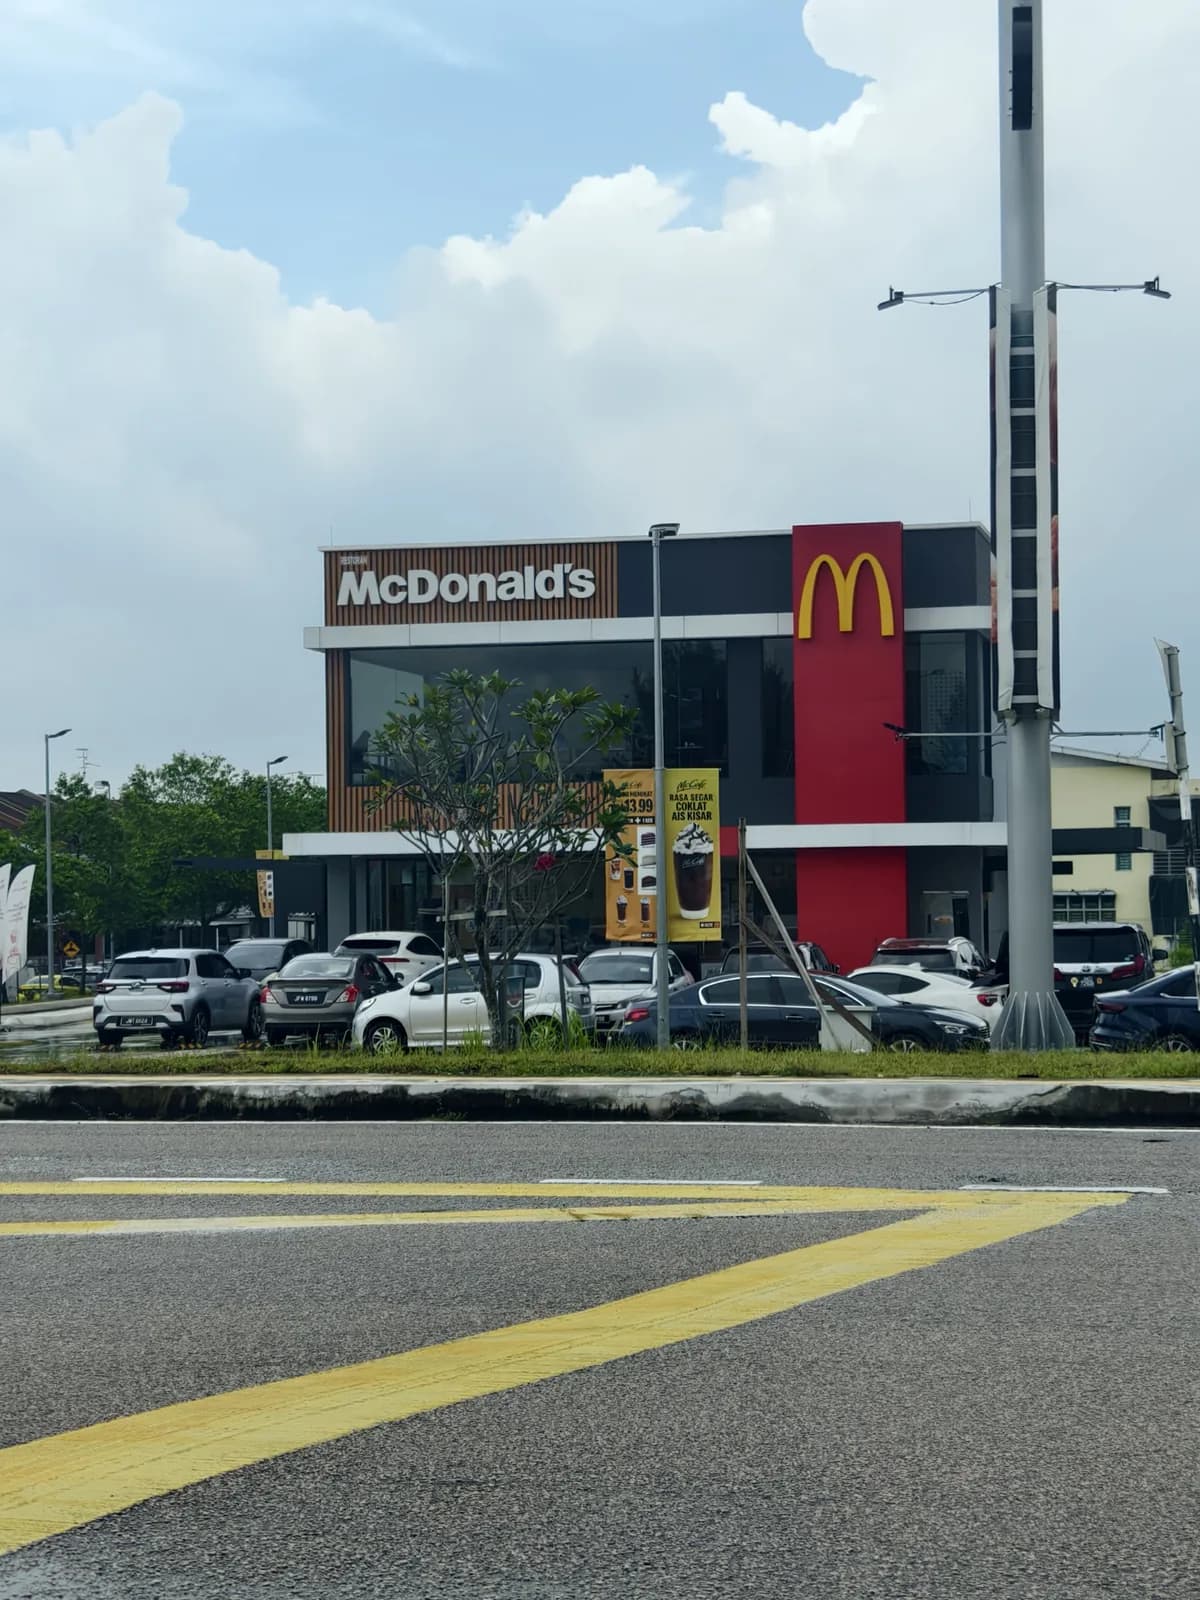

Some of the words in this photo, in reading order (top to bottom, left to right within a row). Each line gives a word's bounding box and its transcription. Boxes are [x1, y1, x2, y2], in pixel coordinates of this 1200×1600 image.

[336, 563, 596, 606] McDonald's
[669, 793, 689, 801] RASA
[676, 802, 707, 811] COKLAT
[672, 811, 686, 821] AIS
[687, 811, 713, 821] KISAR
